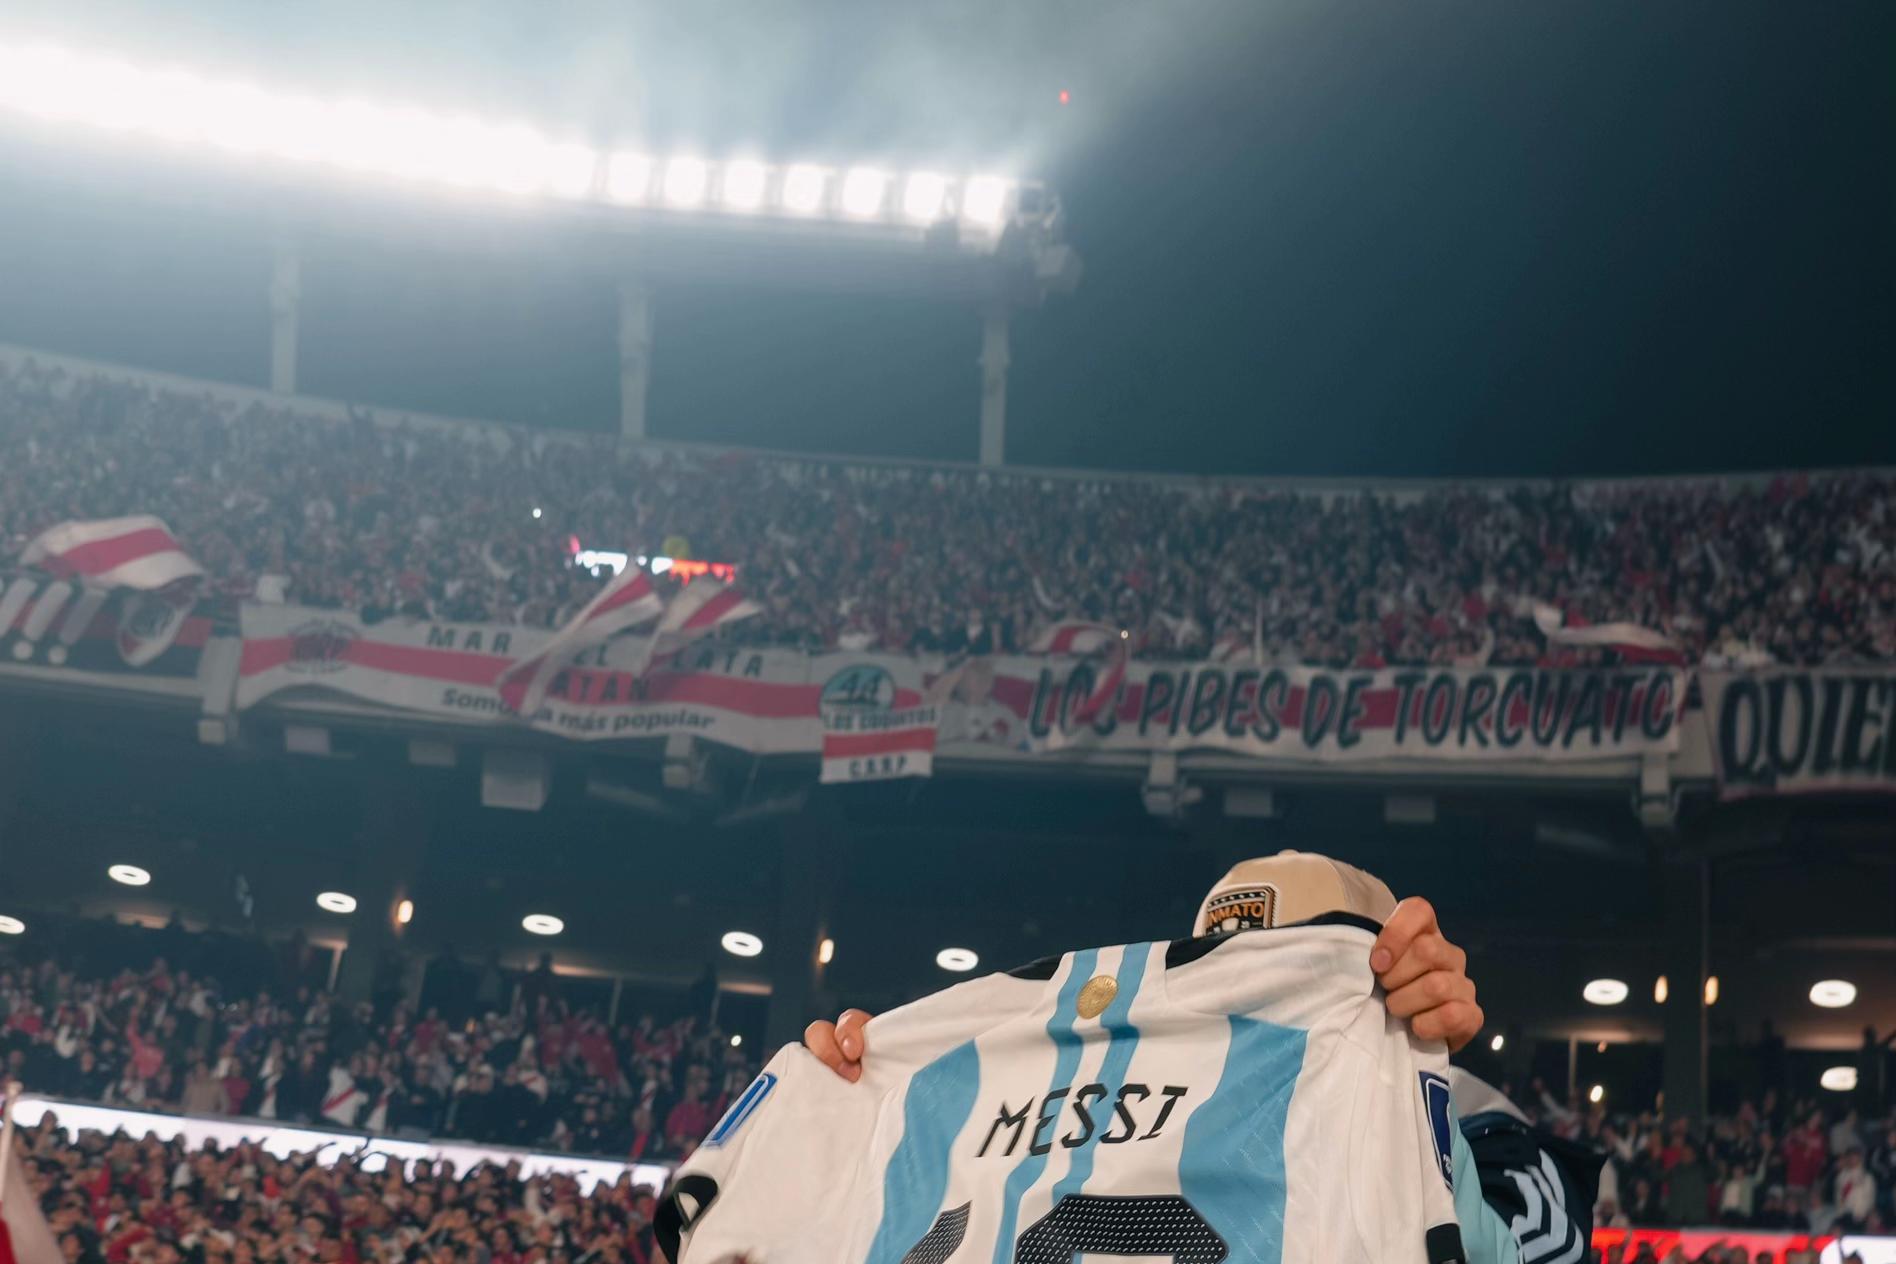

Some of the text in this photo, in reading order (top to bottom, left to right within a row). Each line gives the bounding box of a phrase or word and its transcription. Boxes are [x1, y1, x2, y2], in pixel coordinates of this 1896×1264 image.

[428, 626, 513, 654] MAR
[672, 648, 765, 677] LATA
[612, 707, 717, 732] popular
[1138, 668, 1289, 742] PIBES
[1303, 673, 1375, 749] DE
[1394, 670, 1676, 749] TORCUATO
[1719, 674, 1896, 786] QUIE
[975, 1083, 1188, 1159] MESSI
